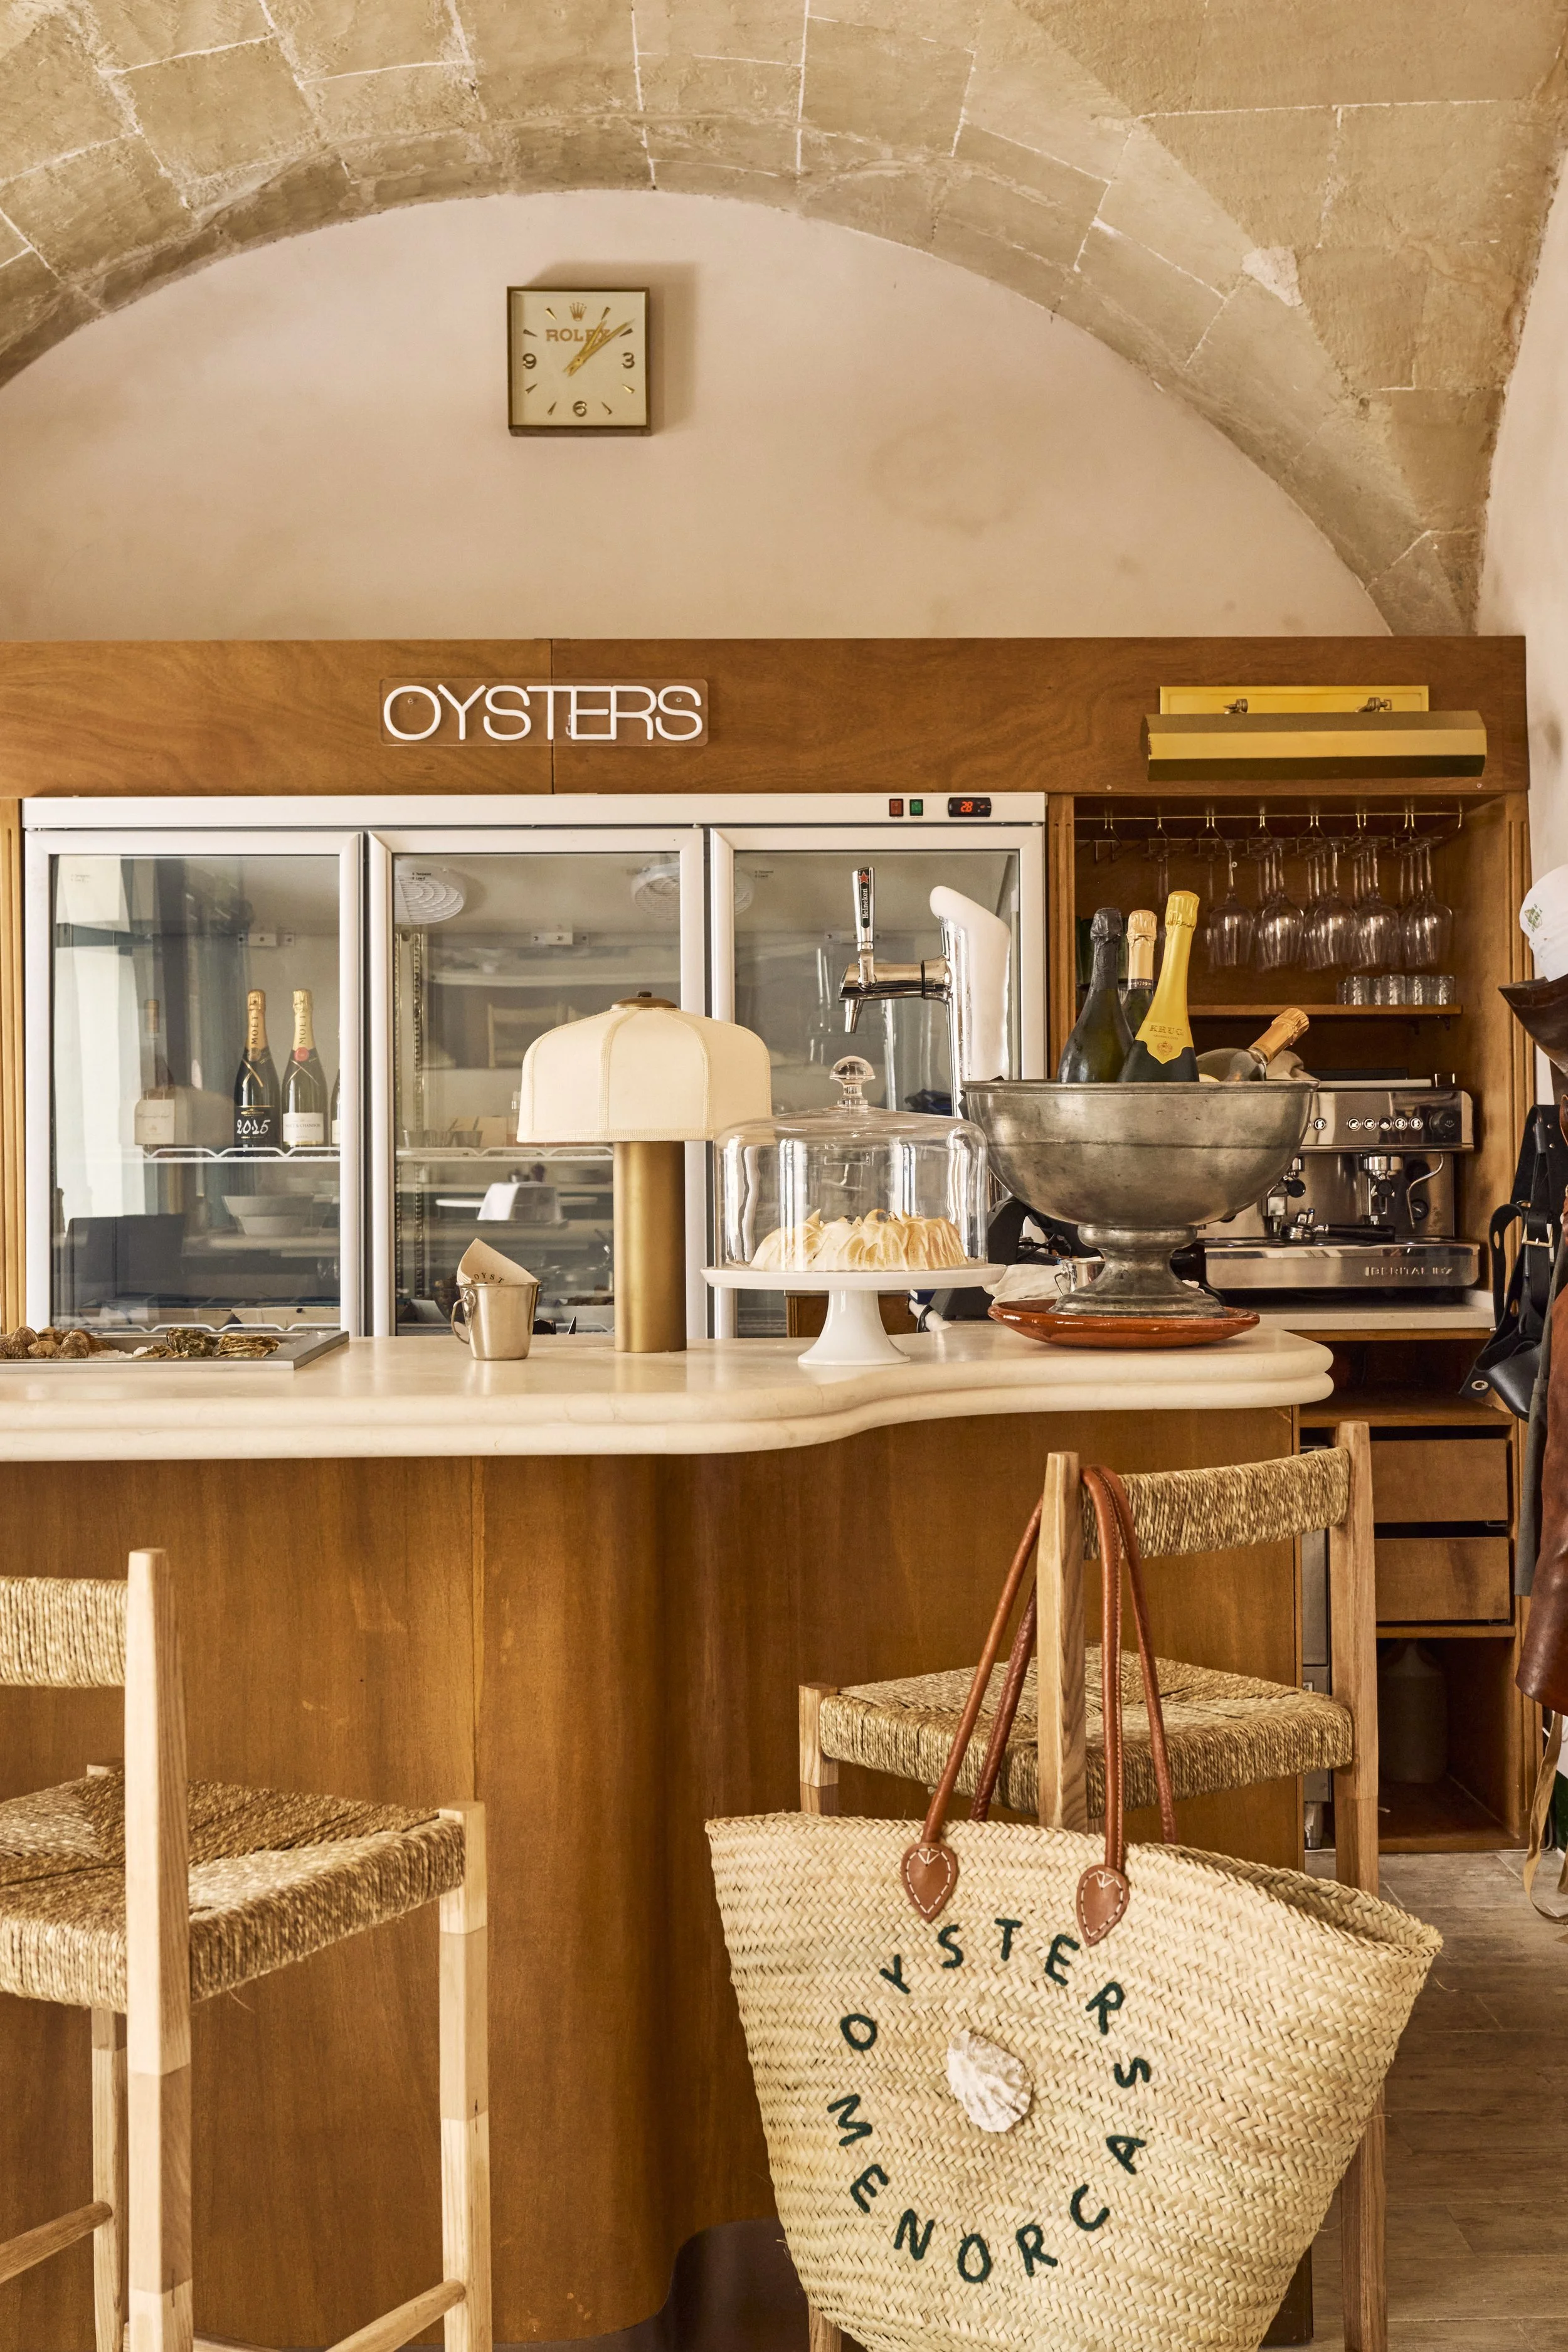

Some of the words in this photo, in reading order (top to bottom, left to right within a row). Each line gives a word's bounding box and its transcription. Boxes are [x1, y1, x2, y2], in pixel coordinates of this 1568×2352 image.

[522, 353, 537, 369] 9
[622, 352, 635, 369] 3
[573, 400, 587, 417] 6
[383, 684, 702, 741] OYSTERS
[1149, 1025, 1184, 1036] KRUG
[840, 1917, 1152, 2089] OYSTERS
[827, 2094, 1147, 2284] MENORCA
